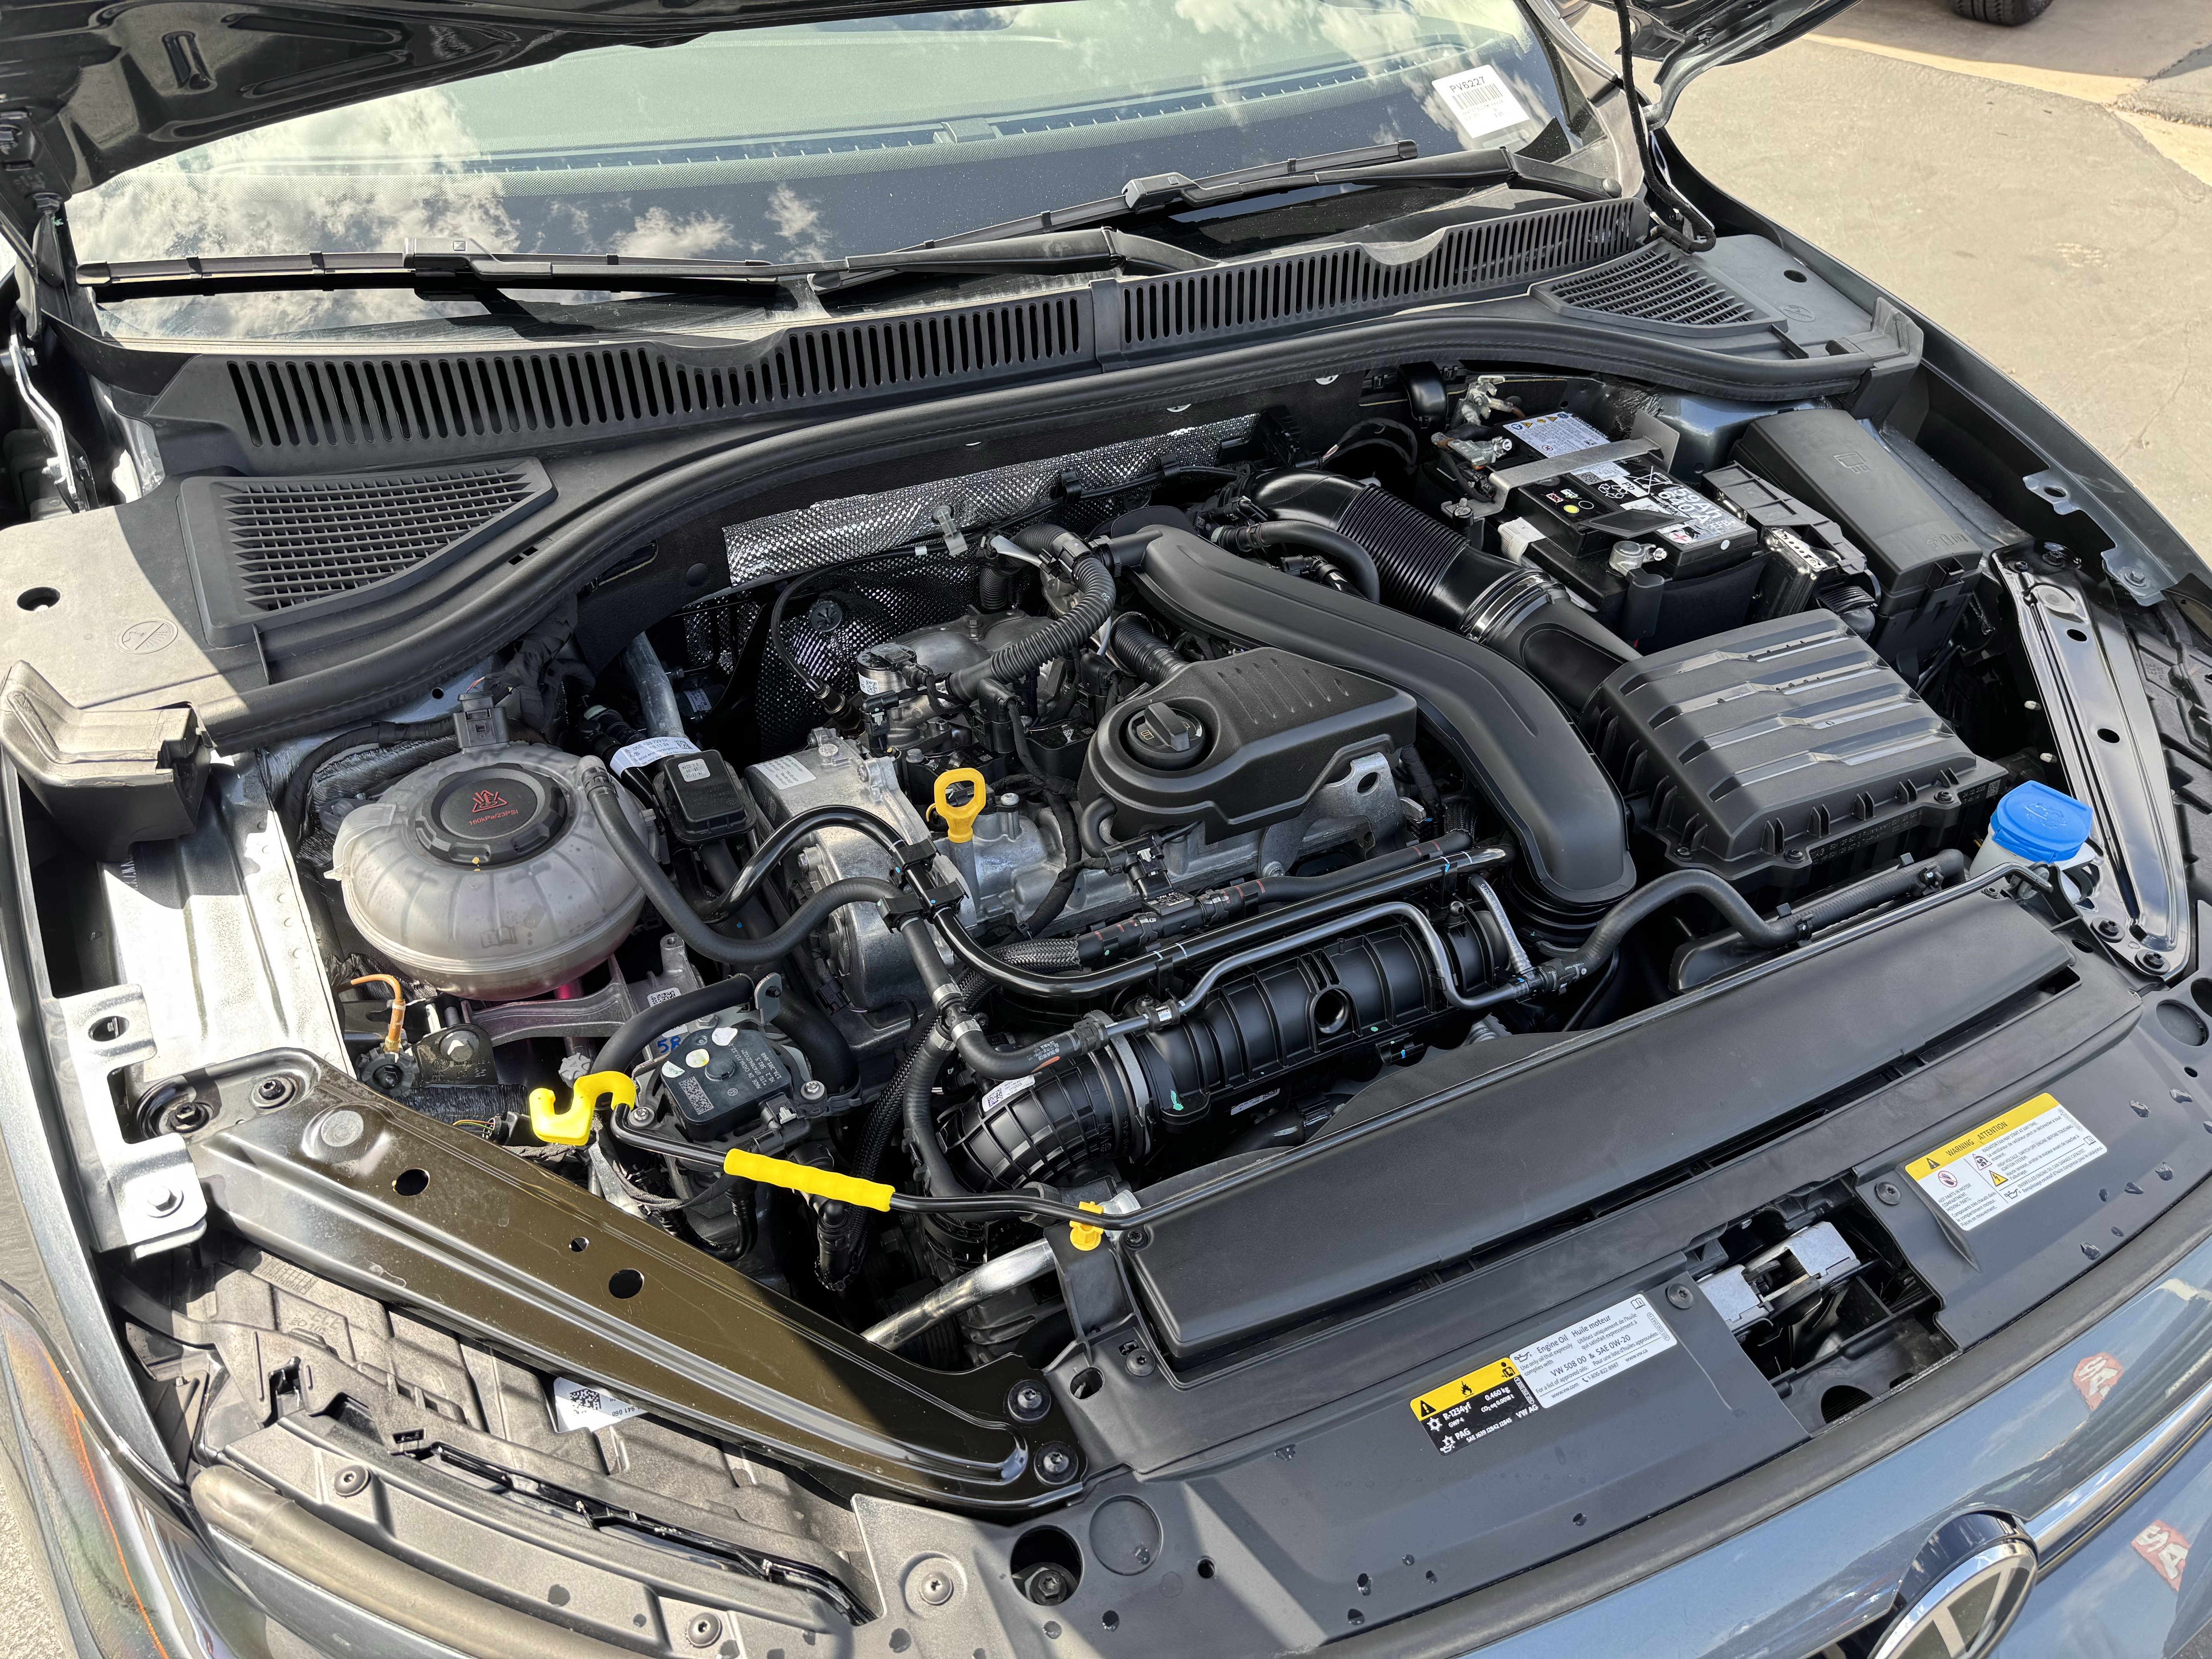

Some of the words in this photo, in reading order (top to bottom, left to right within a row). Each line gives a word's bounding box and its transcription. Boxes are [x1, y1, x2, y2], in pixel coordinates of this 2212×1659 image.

[1449, 76, 1485, 93] PV6227
[1658, 491, 1695, 512] 640
[1690, 514, 1711, 524] A
[469, 809, 518, 826] 160kPa/23PSI
[752, 1079, 762, 1089] MADE
[1977, 1121, 2008, 1140] ATTENTION
[1945, 1139, 1974, 1156] WARNING
[1571, 1326, 1589, 1337] Huile
[1588, 1315, 1611, 1329] moteur
[1577, 1334, 1594, 1344] Utilisez
[1593, 1321, 1619, 1336] uniquement
[1623, 1313, 1637, 1322] l'huile
[1589, 1335, 1606, 1346] satisfait
[1605, 1321, 1634, 1338] expressément
[1536, 1340, 1559, 1353] Engine
[1558, 1334, 1568, 1343] Oil
[1553, 1343, 1573, 1355] expressly
[1620, 1343, 1635, 1353] d'huiles
[1635, 1332, 1659, 1345] approuvées:
[1550, 1366, 1563, 1376] VW
[1563, 1360, 1577, 1370] 508
[1577, 1355, 1587, 1364] 00
[1595, 1344, 1609, 1355] SAE
[1608, 1334, 1630, 1348] 0W-20
[1625, 1349, 1648, 1362] www.vw.ca
[1524, 1364, 1544, 1376] complies
[1559, 1369, 1580, 1382] approved
[1587, 1362, 1618, 1380] 1-800-822-8987
[1484, 1389, 1502, 1401] 0.460
[1551, 1382, 1579, 1398] www.vw.com
[1495, 1395, 1511, 1405] 0.0018
[1442, 1401, 1471, 1420] R-1234yf
[1515, 1408, 1528, 1418] VW
[1528, 1404, 1538, 1413] AG
[1448, 1419, 1460, 1427] GWP
[1466, 1434, 1476, 1443] SAE
[1475, 1429, 1486, 1438] J639
[1486, 1423, 1499, 1433] J2842
[1498, 1417, 1512, 1427] J2845
[1454, 1427, 1471, 1440] PAG
